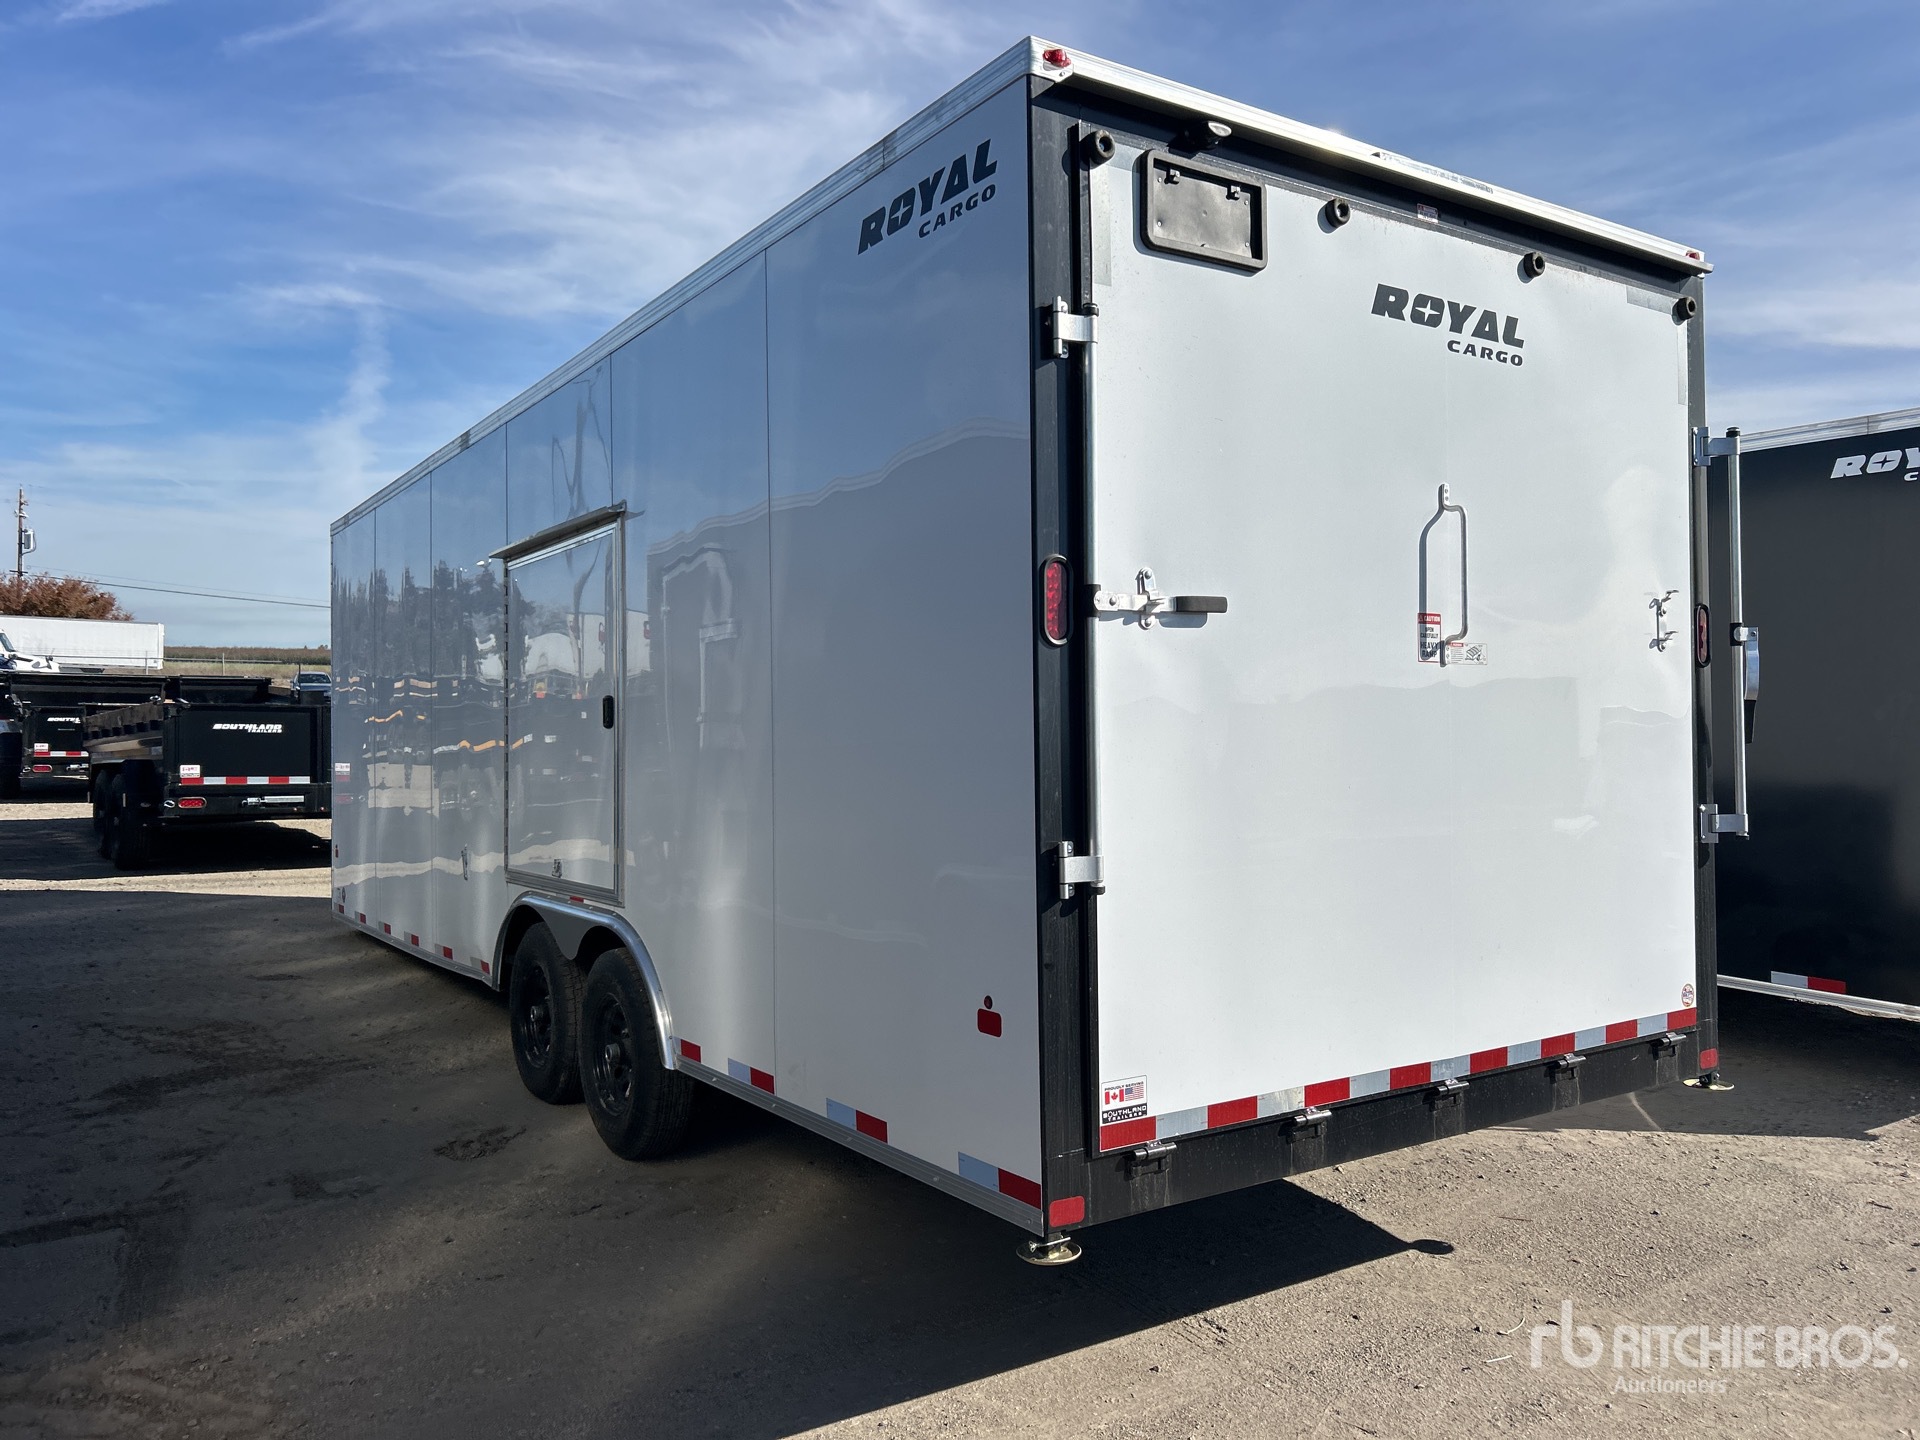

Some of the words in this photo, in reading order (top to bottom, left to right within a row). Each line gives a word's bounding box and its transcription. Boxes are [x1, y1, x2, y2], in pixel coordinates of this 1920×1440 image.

[858, 138, 997, 255] ROYAL
[918, 184, 997, 239] CARGO
[1371, 283, 1525, 349] ROYAL
[1446, 339, 1524, 368] CARGO
[1103, 1106, 1146, 1118] SOUTHLAND
[1108, 1112, 1142, 1121] TRAILERS
